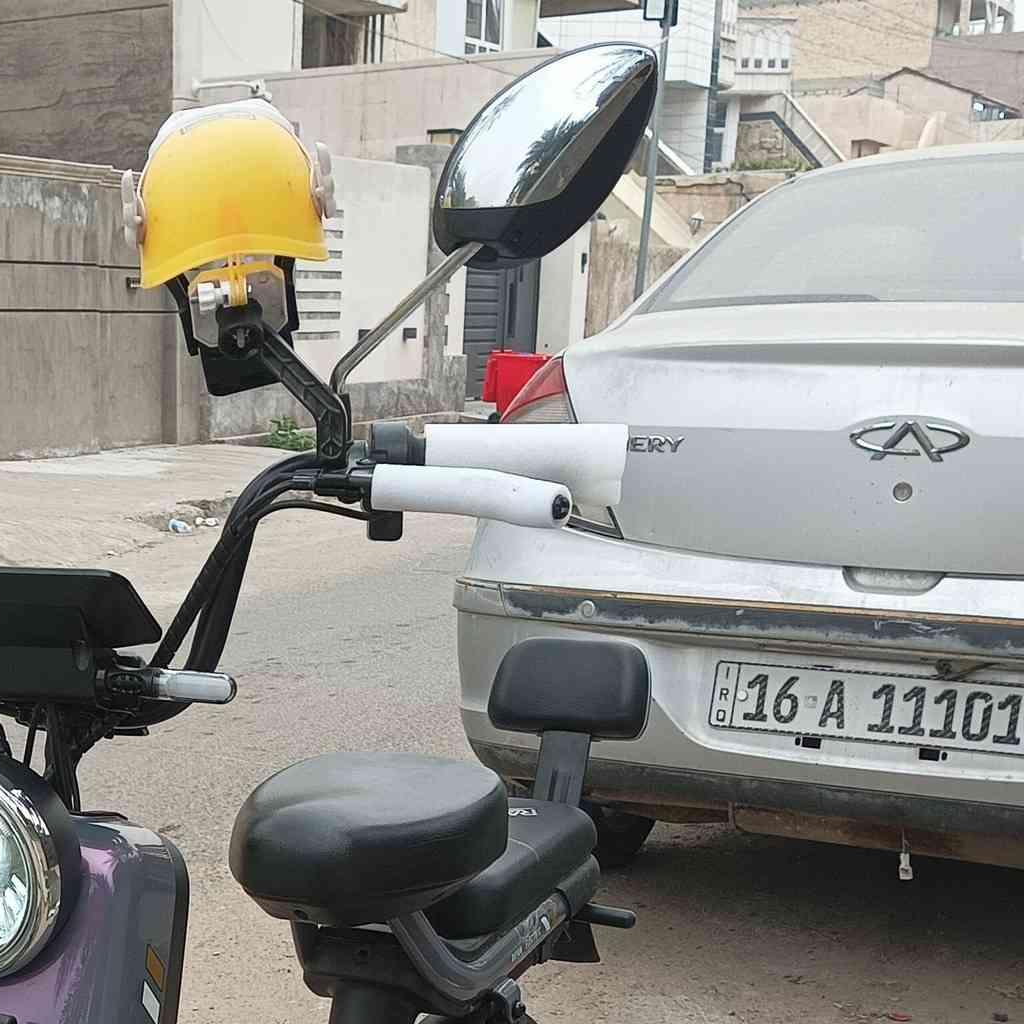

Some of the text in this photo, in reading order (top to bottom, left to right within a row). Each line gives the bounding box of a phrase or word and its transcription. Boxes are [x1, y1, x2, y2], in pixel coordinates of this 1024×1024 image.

[627, 435, 685, 453] ERY
[743, 674, 1023, 745] 16 A 11101
